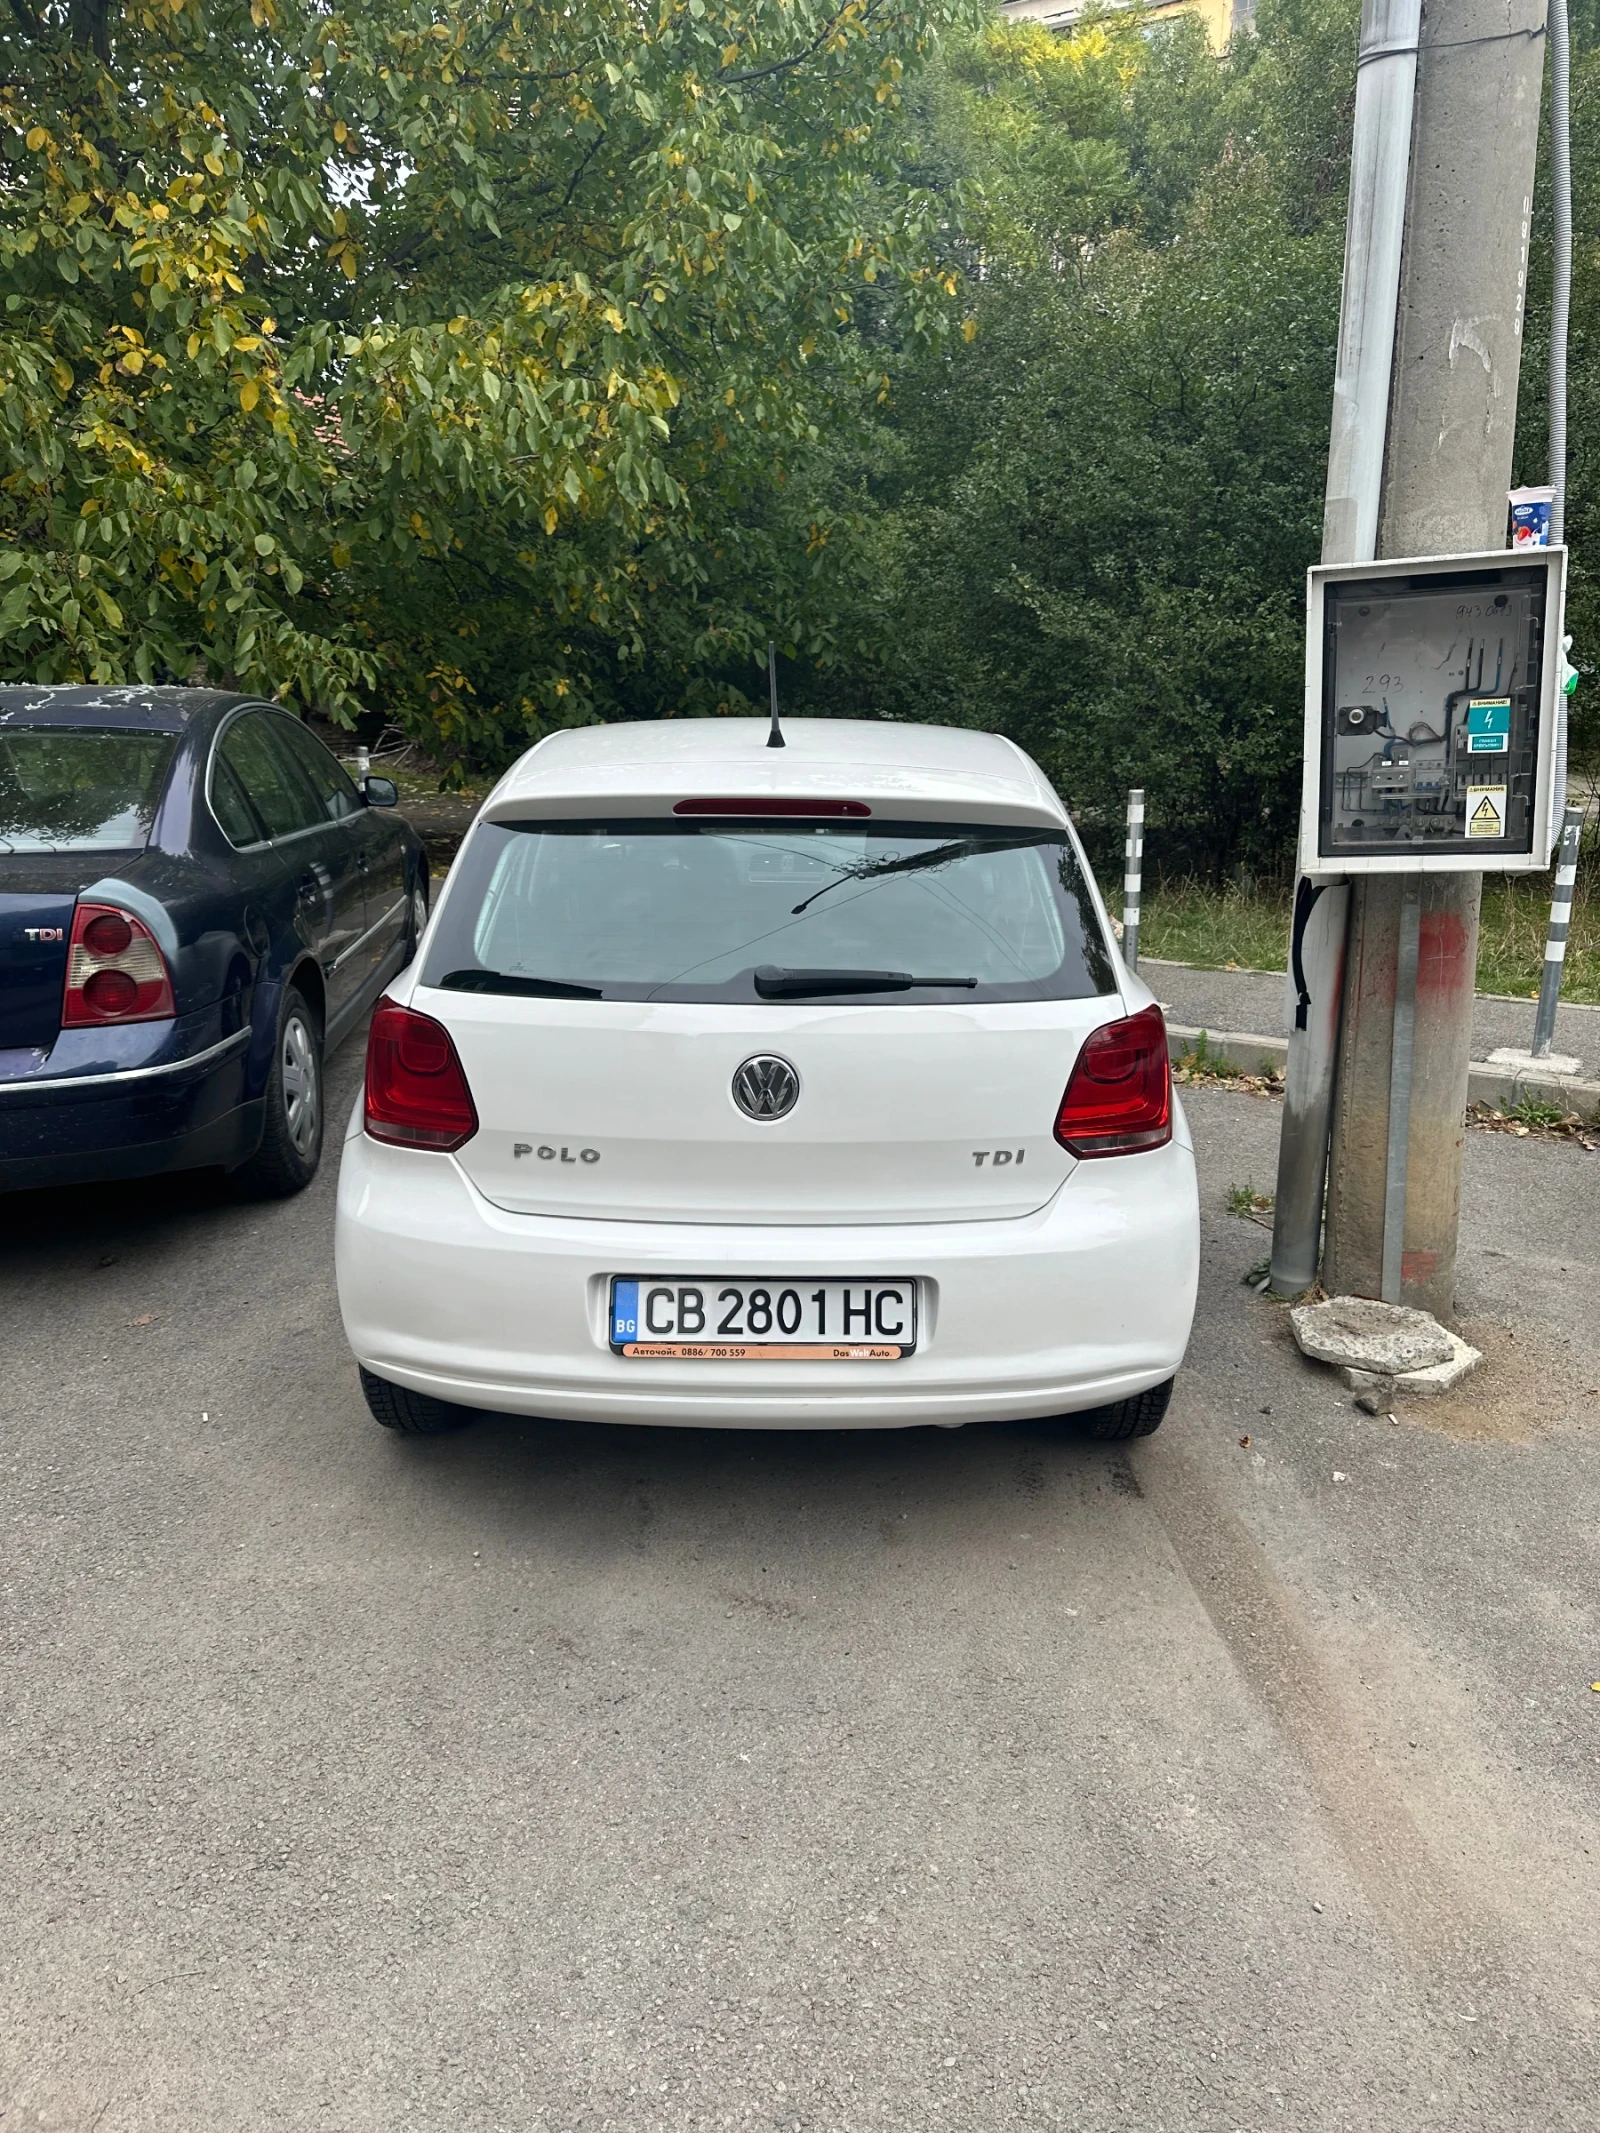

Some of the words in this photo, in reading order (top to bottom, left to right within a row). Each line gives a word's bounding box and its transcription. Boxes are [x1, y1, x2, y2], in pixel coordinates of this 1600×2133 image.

[1362, 673, 1404, 694] 293
[24, 928, 63, 941] TDI
[514, 1143, 601, 1163] POLO
[972, 1148, 1025, 1167] TDI
[646, 1287, 706, 1335] CB
[716, 1288, 826, 1335] 2801
[843, 1289, 904, 1336] HC
[615, 1319, 635, 1333] BG
[632, 1347, 677, 1356] Авточойс
[711, 1348, 727, 1356] 700
[729, 1348, 746, 1357] 559
